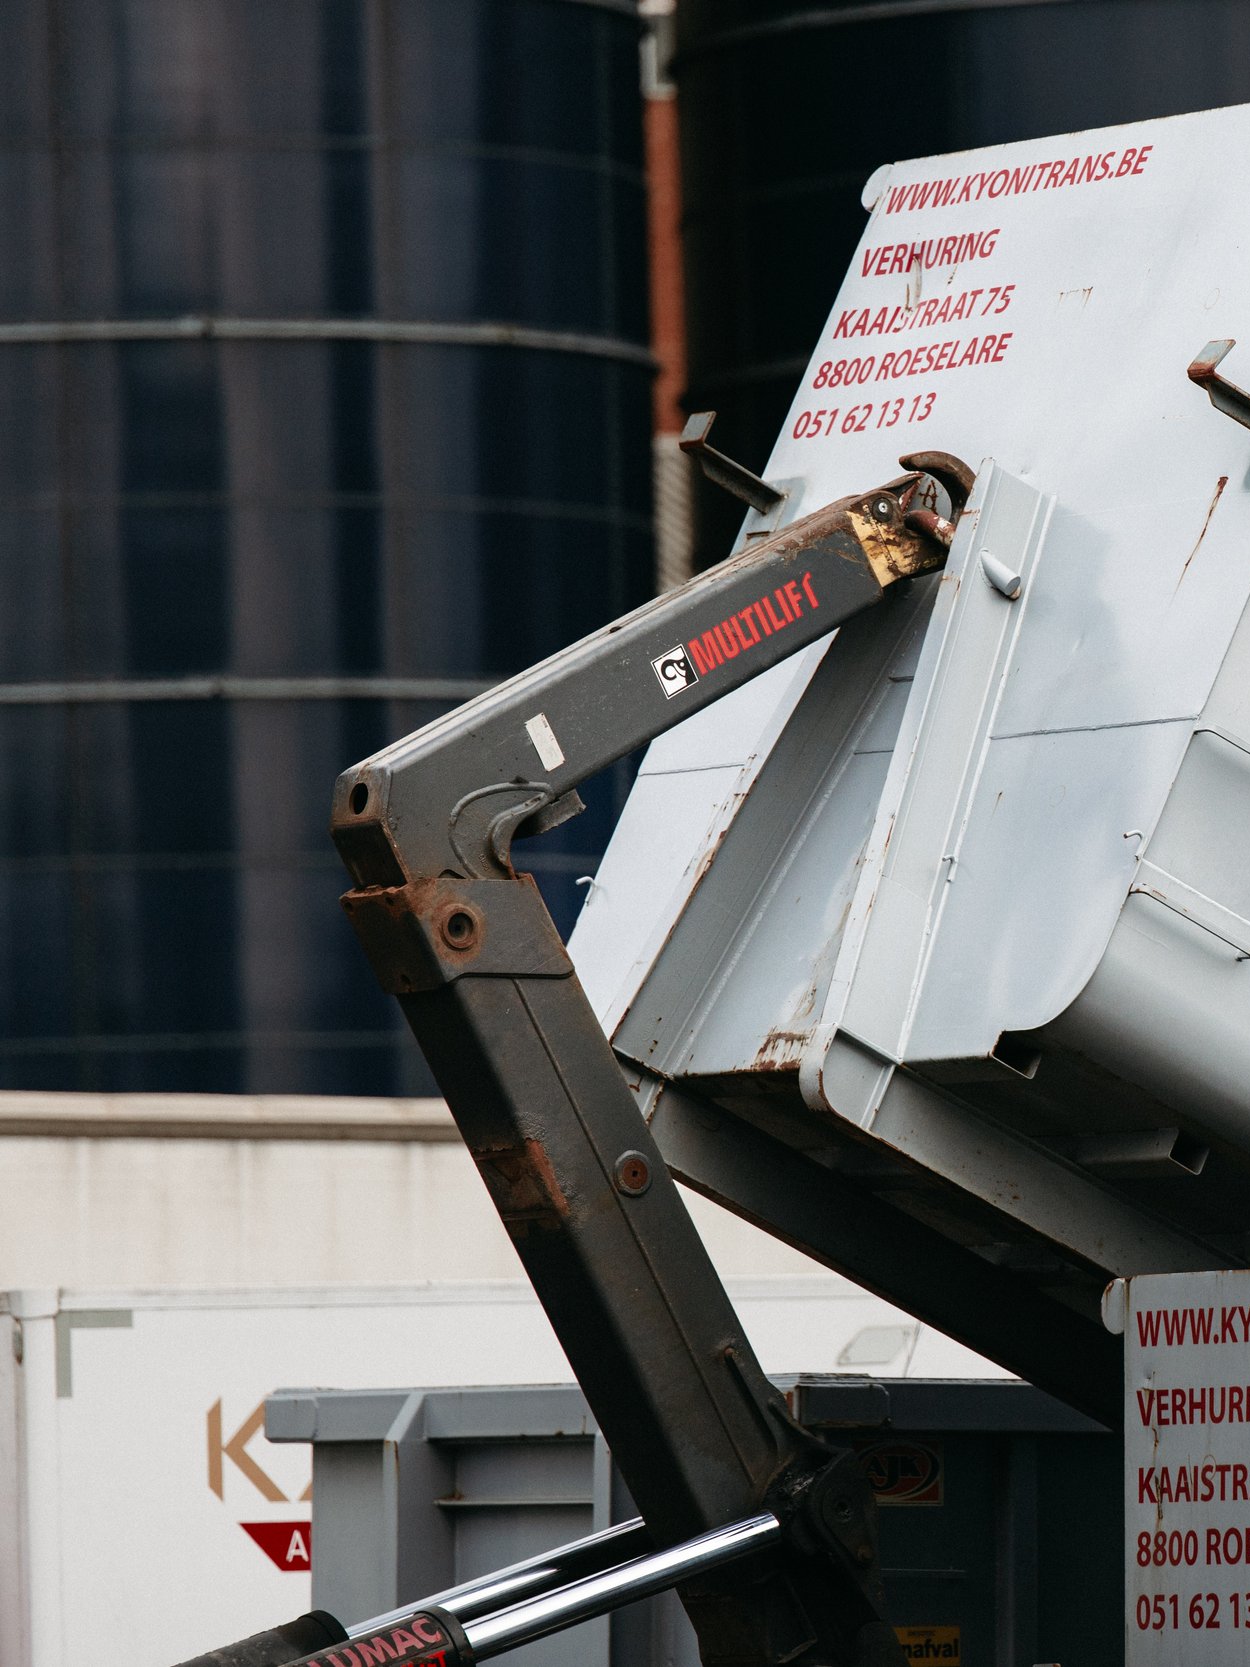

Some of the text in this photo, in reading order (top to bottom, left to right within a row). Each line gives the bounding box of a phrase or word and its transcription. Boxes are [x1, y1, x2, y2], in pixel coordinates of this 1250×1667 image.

[886, 145, 1153, 215] WWW.KYONITRANS.BE
[861, 229, 1000, 277] VERHURING
[833, 285, 1015, 339] KAAISTRAAT 75
[813, 333, 1013, 389] 8800 ROESELARE
[792, 393, 936, 439] 051 62 13 13
[1137, 1531, 1198, 1566] 8800
[1137, 1595, 1179, 1629] 051
[1189, 1594, 1219, 1629] 62
[307, 1619, 441, 1667] UMAC
